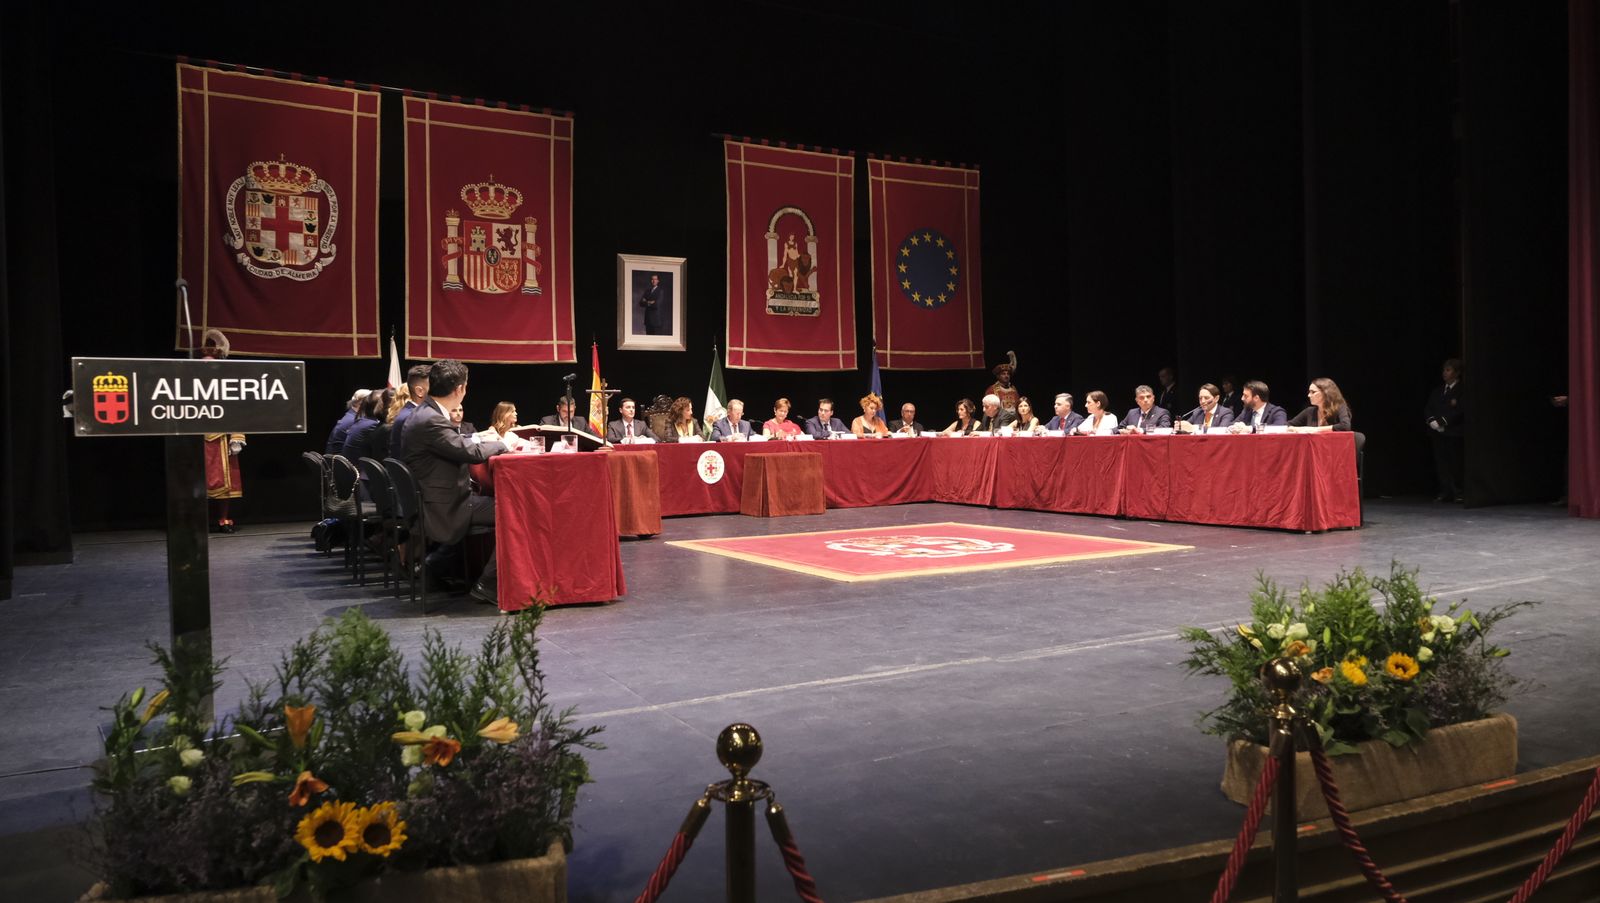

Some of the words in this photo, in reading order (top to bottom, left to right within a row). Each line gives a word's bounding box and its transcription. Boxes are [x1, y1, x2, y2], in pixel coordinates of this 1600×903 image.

[248, 265, 274, 277] CIUDAD
[151, 373, 289, 401] ALMERÍA
[151, 404, 224, 420] CIUDAD
